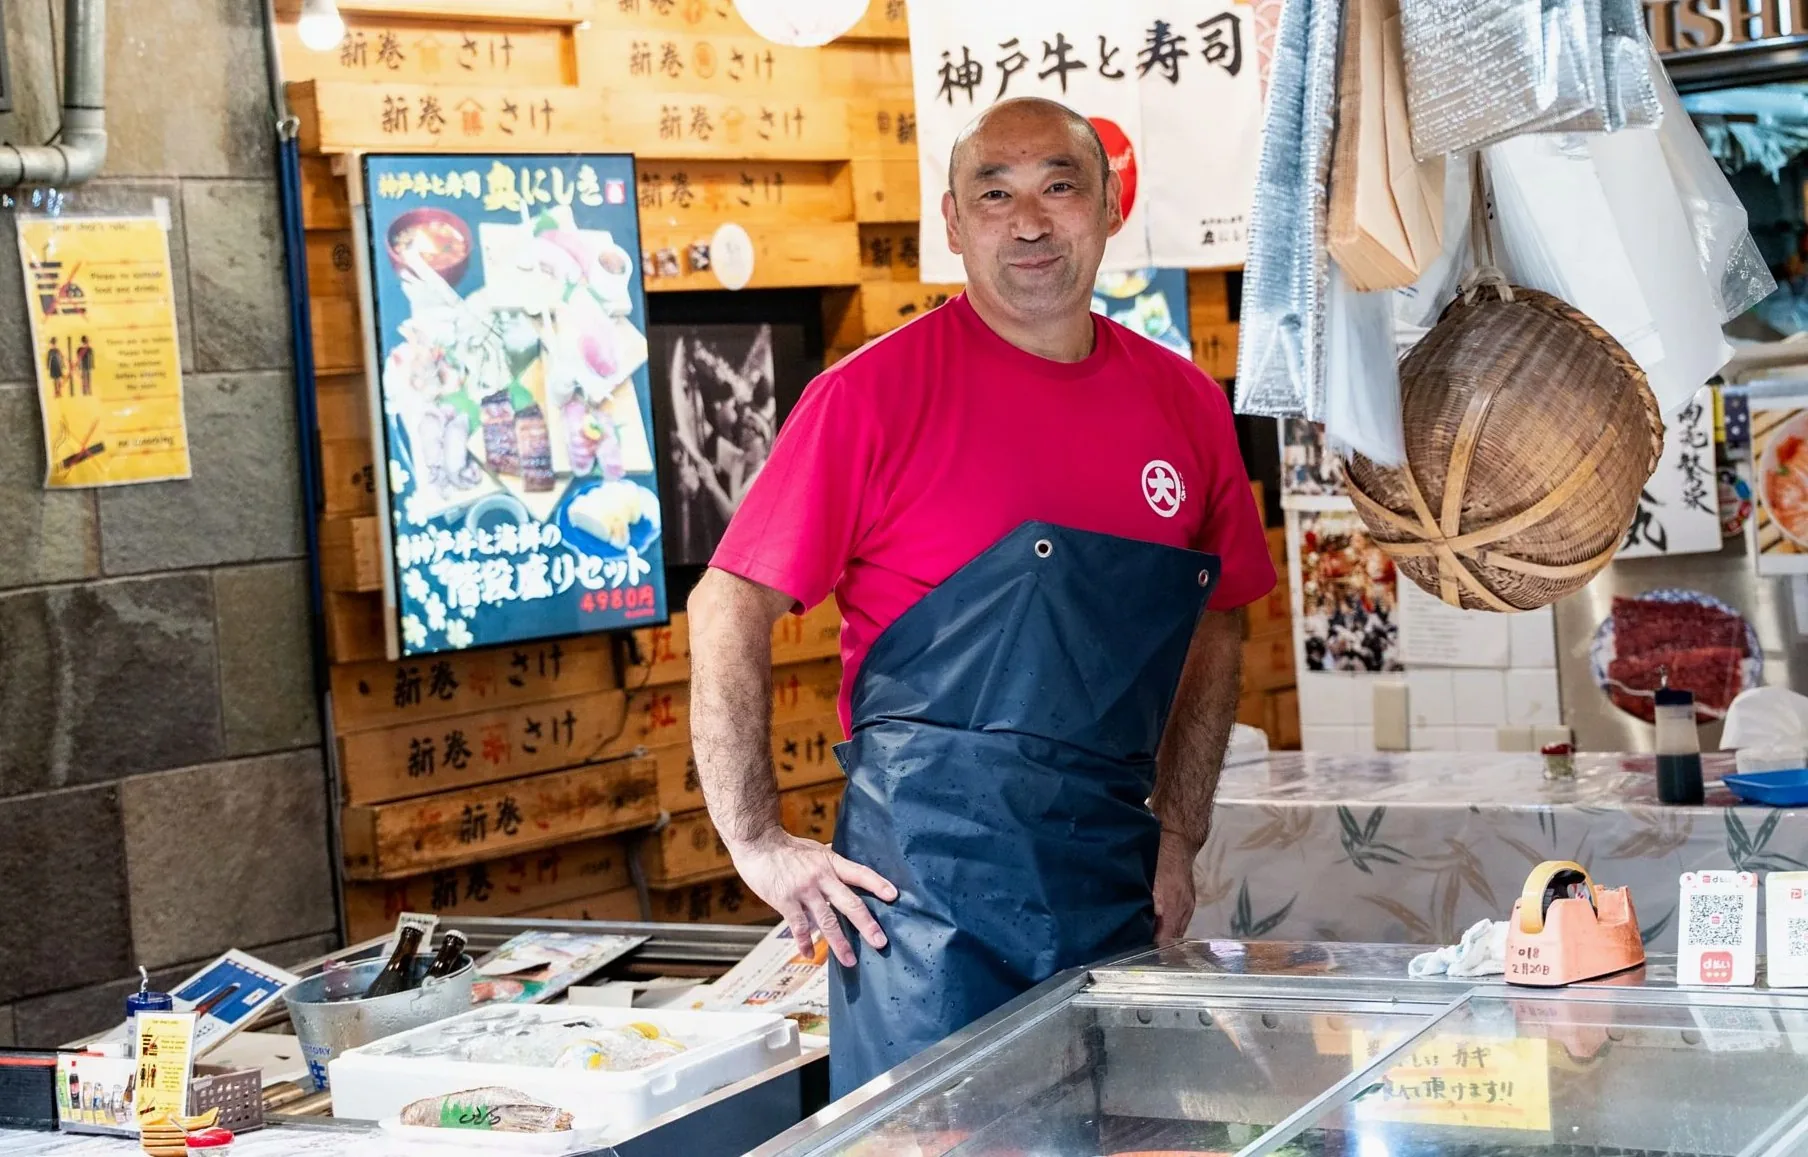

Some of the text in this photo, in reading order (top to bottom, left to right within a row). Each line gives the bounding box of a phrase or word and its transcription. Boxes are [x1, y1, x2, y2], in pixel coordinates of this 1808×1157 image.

[936, 11, 1242, 106] 神戸牛と寿司
[381, 95, 556, 135] 新巻 さけ
[659, 105, 805, 141] 新巻 さけ
[1146, 466, 1177, 507] 大
[394, 643, 564, 708] 新巻 さけ
[408, 729, 473, 778] 新巻
[522, 709, 577, 754] さけ
[459, 795, 523, 845] 新巻
